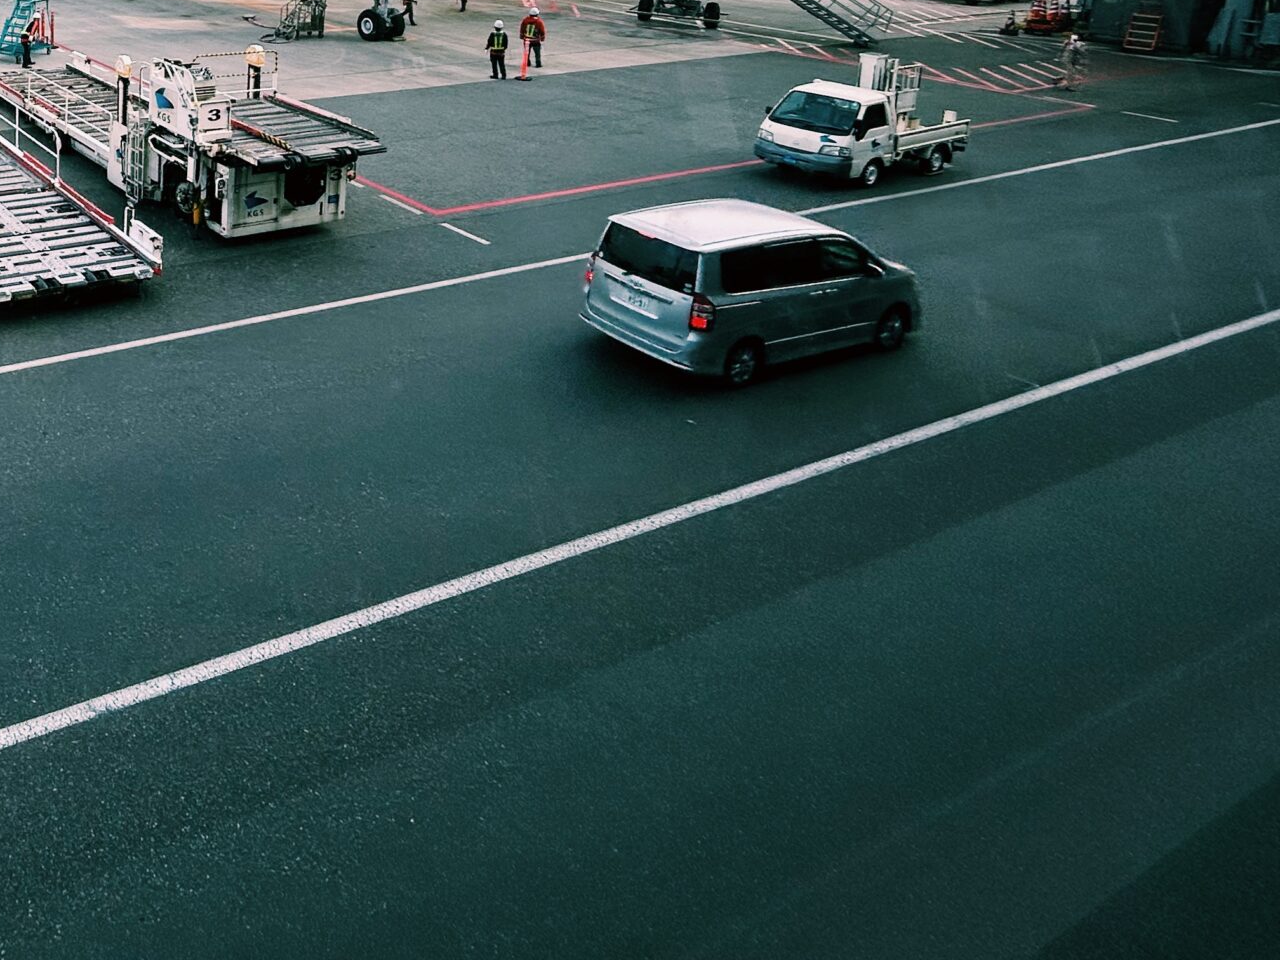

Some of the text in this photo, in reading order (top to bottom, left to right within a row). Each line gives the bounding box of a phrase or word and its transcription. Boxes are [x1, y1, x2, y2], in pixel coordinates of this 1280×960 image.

[157, 111, 172, 124] KGS
[207, 108, 222, 122] 3
[329, 169, 342, 181] 3
[247, 208, 264, 218] KGS
